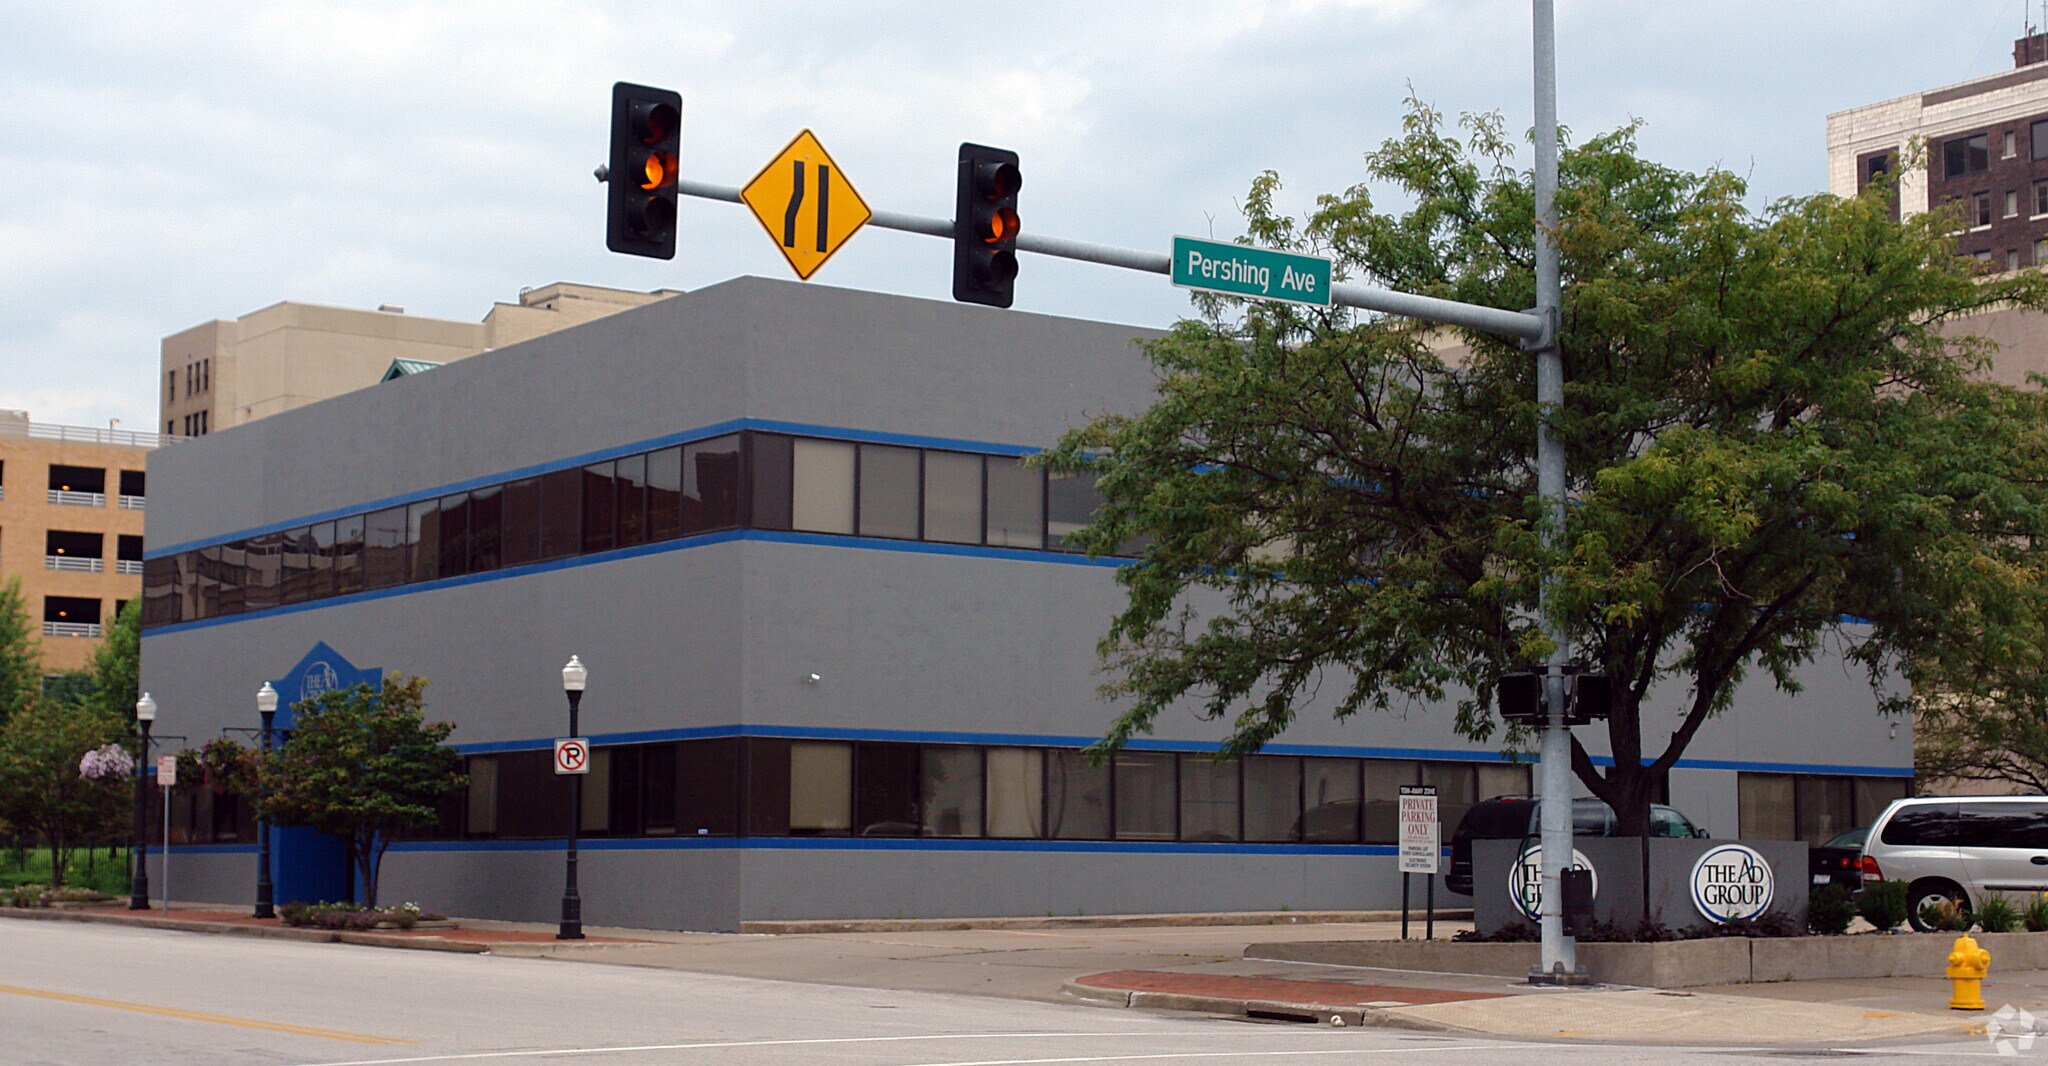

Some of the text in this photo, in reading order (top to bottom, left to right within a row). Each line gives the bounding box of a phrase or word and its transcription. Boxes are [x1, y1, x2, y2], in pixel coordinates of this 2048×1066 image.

[1188, 250, 1316, 294] Pershing Ave
[306, 674, 322, 689] THE
[1424, 787, 1435, 795] ZONE
[1402, 799, 1434, 810] PRIVATE
[1401, 811, 1435, 823] PARKING
[1408, 824, 1428, 835] ONLY
[1704, 857, 1764, 884] THE AD
[1704, 884, 1764, 905] GROUP
